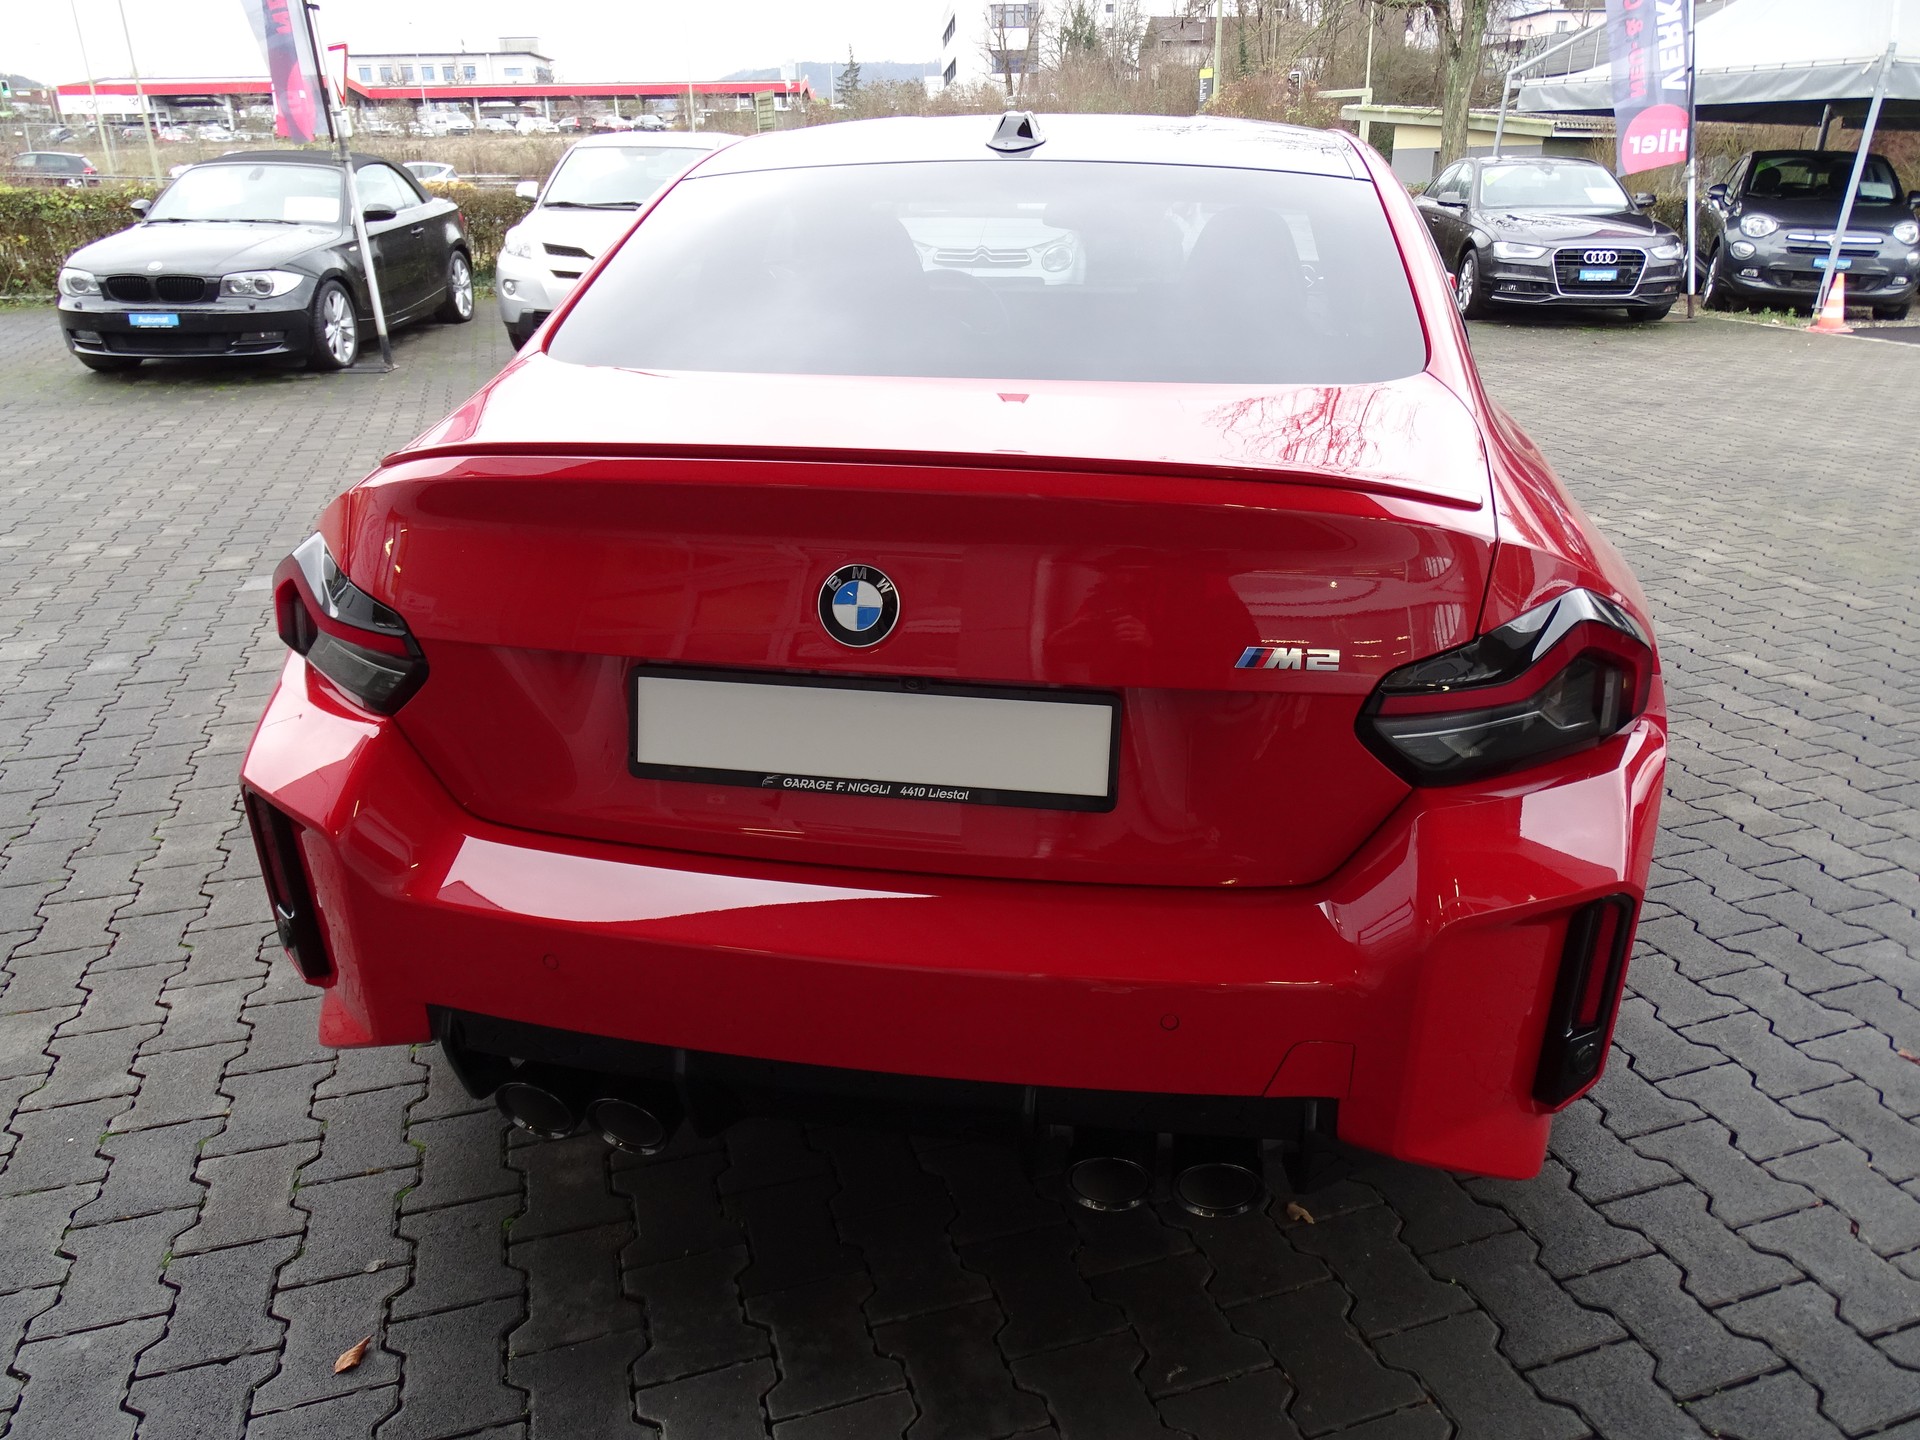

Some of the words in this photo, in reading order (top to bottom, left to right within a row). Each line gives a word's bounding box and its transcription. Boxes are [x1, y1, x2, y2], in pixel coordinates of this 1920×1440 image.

[827, 566, 894, 594] BMW
[1263, 646, 1341, 671] M2
[782, 777, 835, 791] GARAGE
[835, 781, 845, 792] F.
[847, 782, 891, 796] NIGGLI
[899, 786, 926, 797] 4410
[927, 788, 970, 801] Liestal
